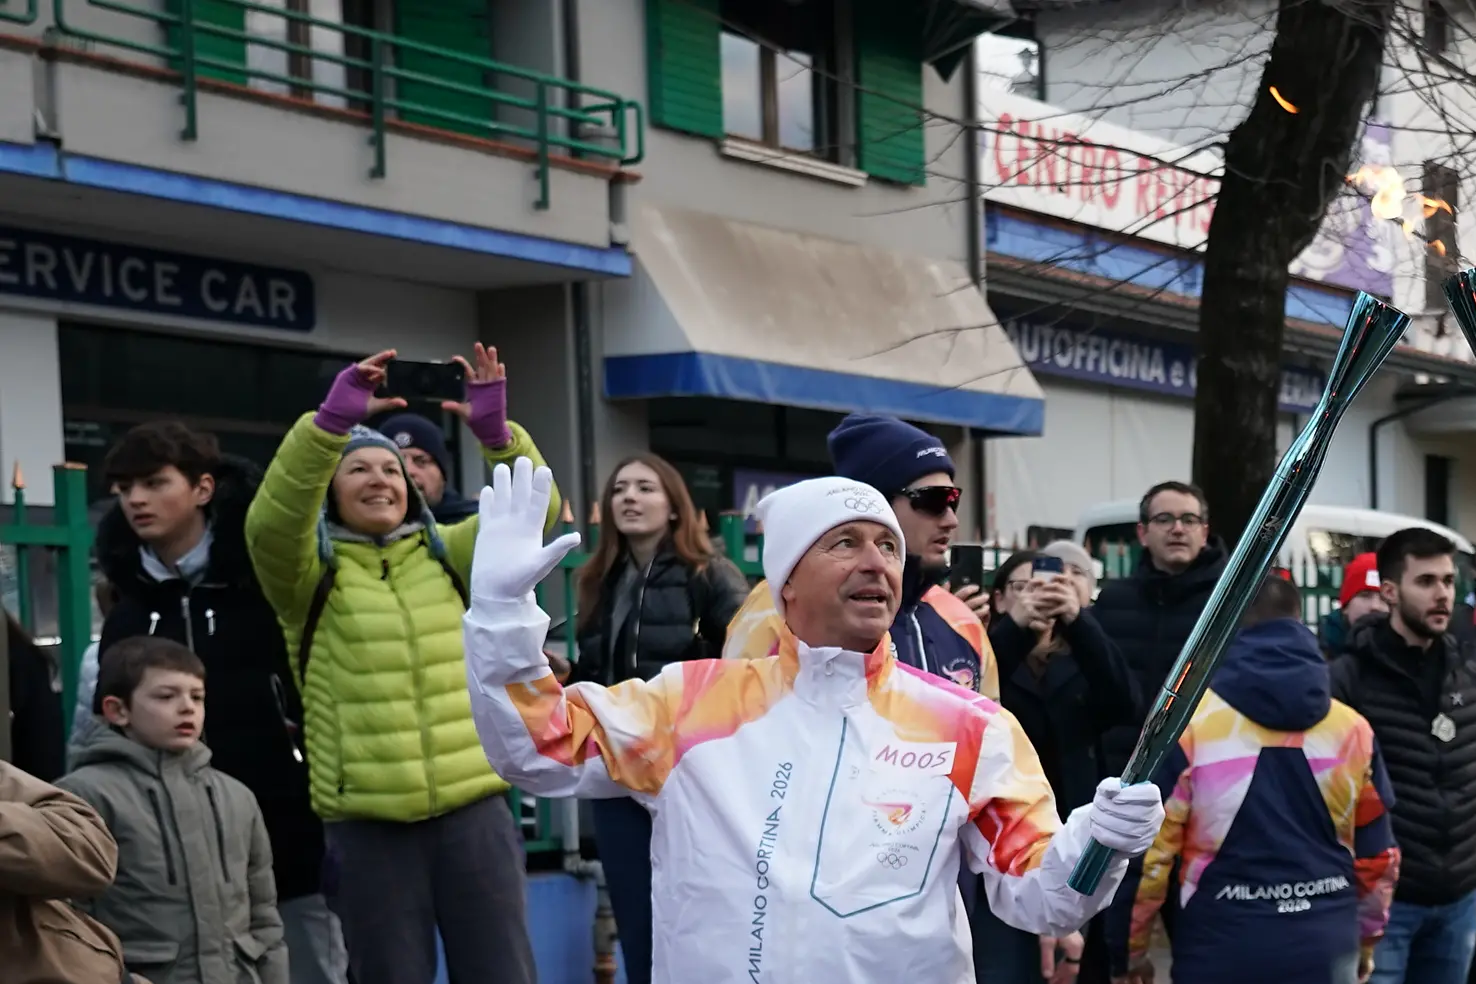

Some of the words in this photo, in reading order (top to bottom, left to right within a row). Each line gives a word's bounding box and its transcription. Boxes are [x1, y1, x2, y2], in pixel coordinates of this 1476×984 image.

[994, 112, 1122, 212] CENTRO
[201, 269, 297, 323] CAR
[757, 805, 782, 890] CORTINA
[770, 761, 793, 799] 2026
[1215, 883, 1293, 901] MILANO
[1293, 875, 1350, 897] CORTINA
